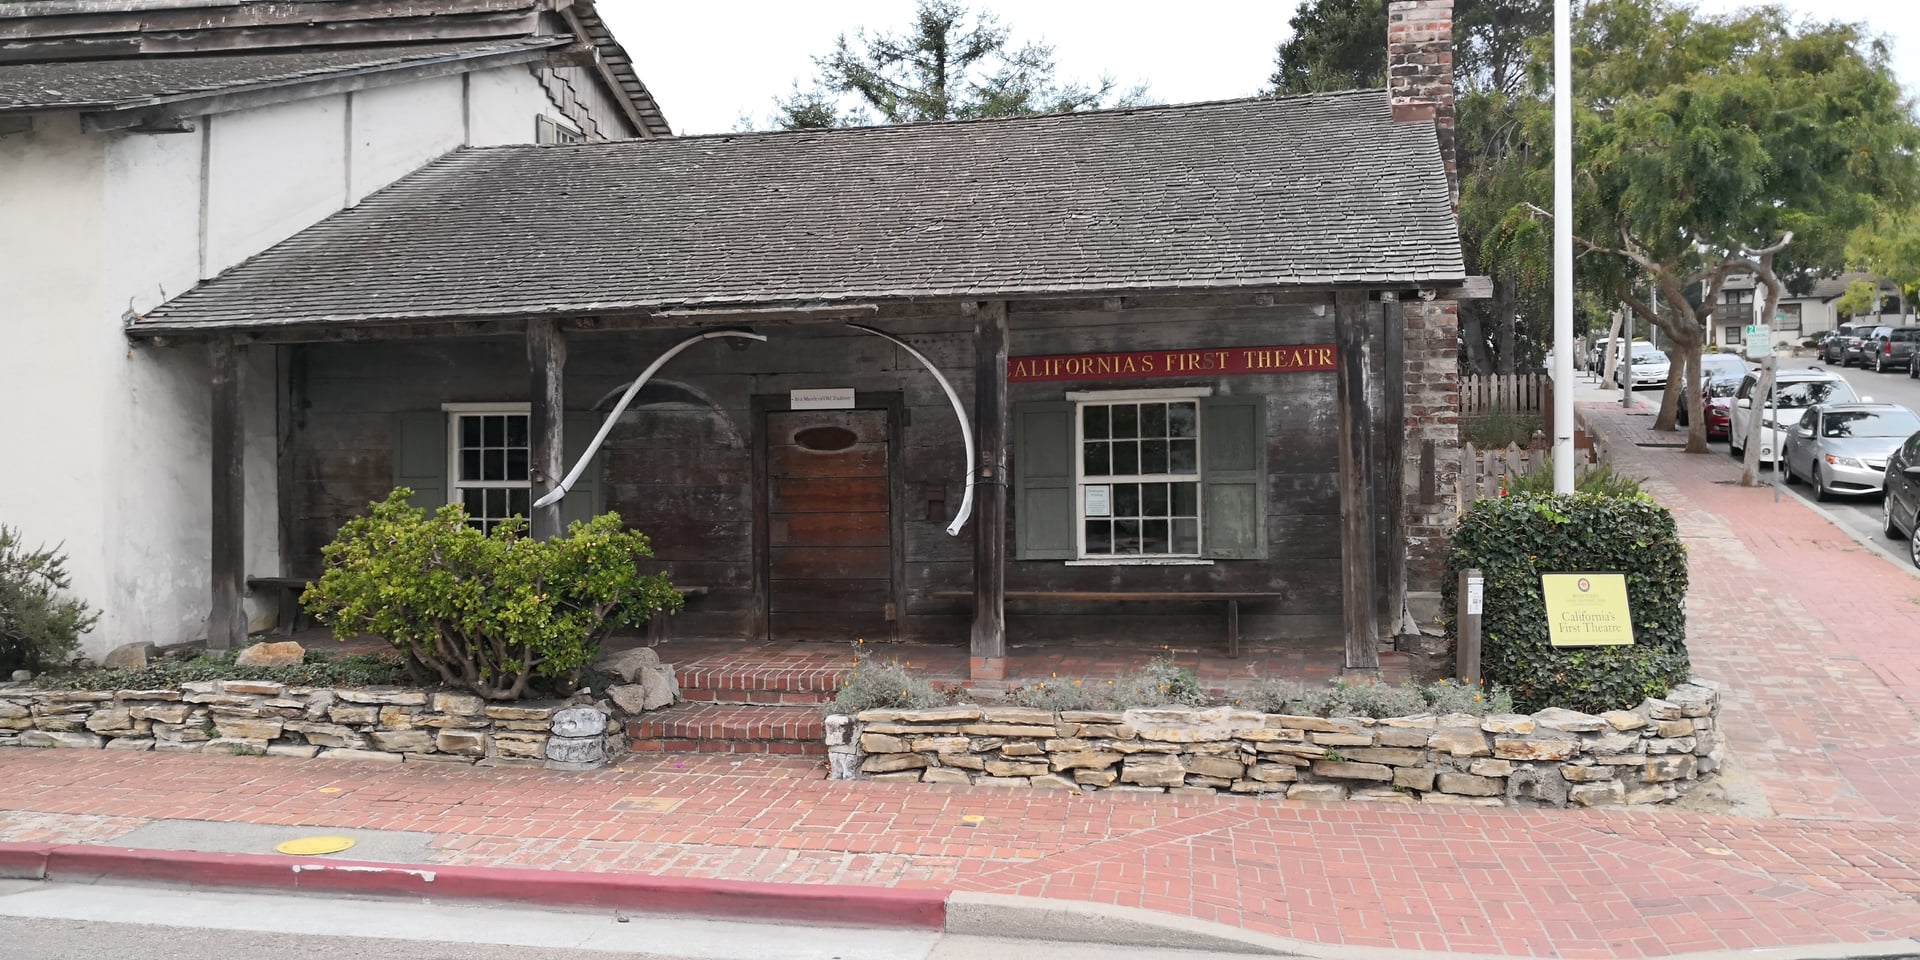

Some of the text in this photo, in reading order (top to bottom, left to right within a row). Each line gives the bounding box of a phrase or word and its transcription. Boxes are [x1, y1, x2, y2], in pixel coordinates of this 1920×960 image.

[1165, 352, 1229, 371] FIRST
[1561, 610, 1616, 622] California's
[1559, 622, 1622, 633] First Theatre
